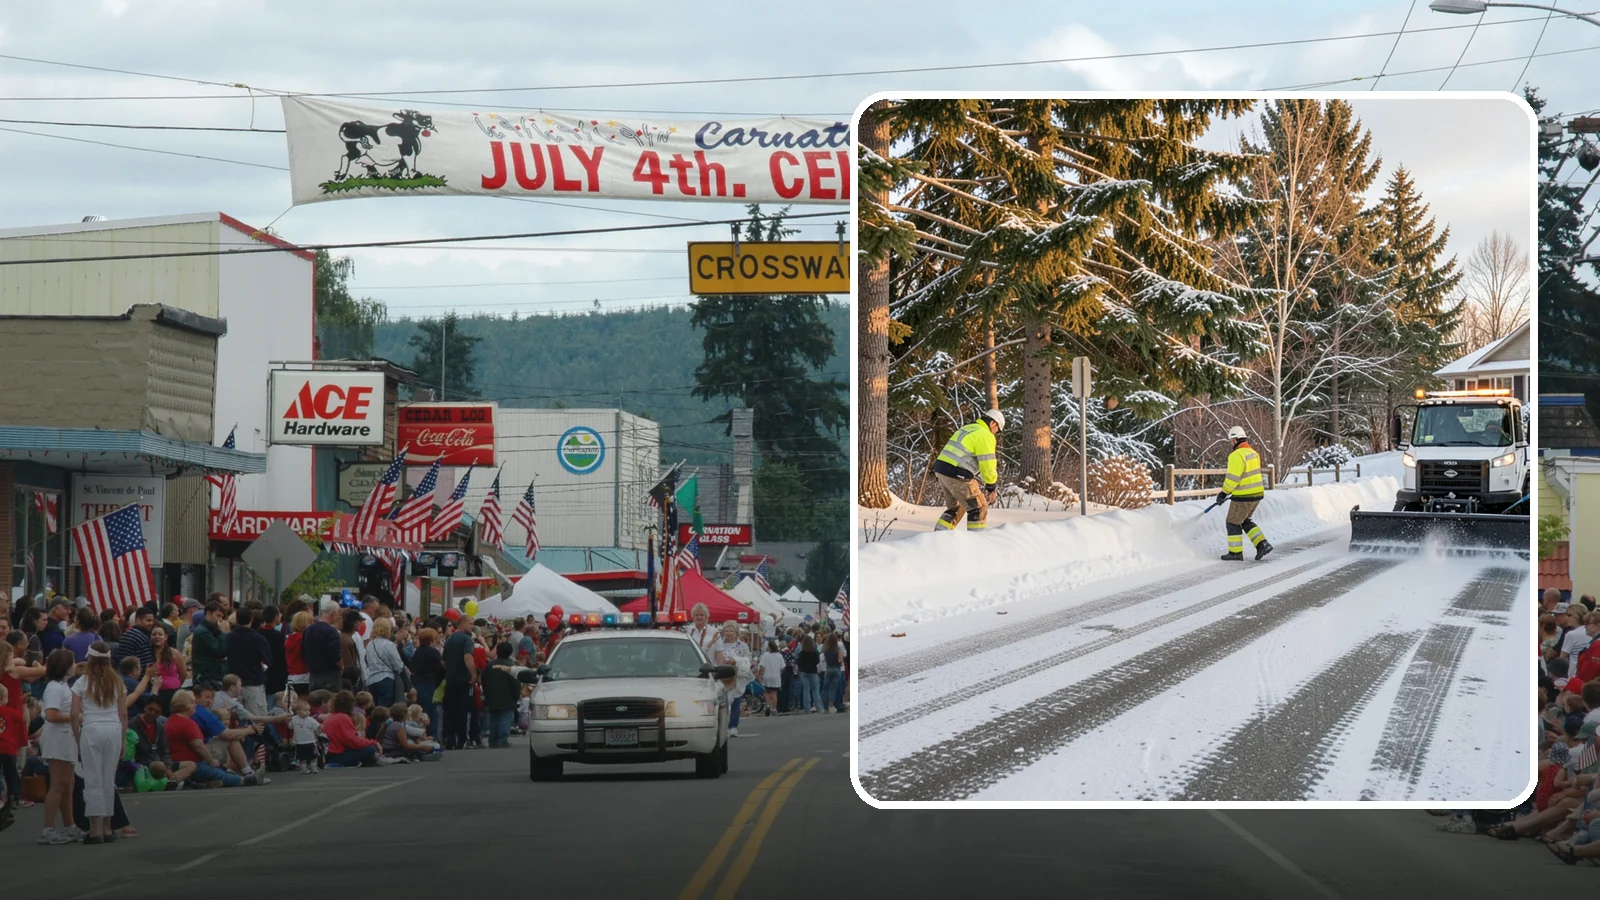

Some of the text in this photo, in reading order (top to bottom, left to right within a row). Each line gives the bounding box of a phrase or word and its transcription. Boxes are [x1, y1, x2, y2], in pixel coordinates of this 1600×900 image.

[695, 121, 850, 149] Carnat
[481, 141, 604, 192] JULY
[632, 150, 746, 197] 4th.
[697, 254, 850, 280] CROSSWA
[282, 380, 373, 419] ACE
[406, 409, 452, 421] CEDAR
[283, 421, 370, 436] Hardware
[416, 428, 477, 446] Coca-Cola
[353, 467, 387, 480] Simpl
[96, 485, 124, 495] Vincent
[126, 486, 136, 495] de
[138, 486, 155, 495] Paul
[212, 516, 331, 535] HARDARE
[688, 526, 742, 535] CRNATION
[699, 535, 730, 543] GLASS
